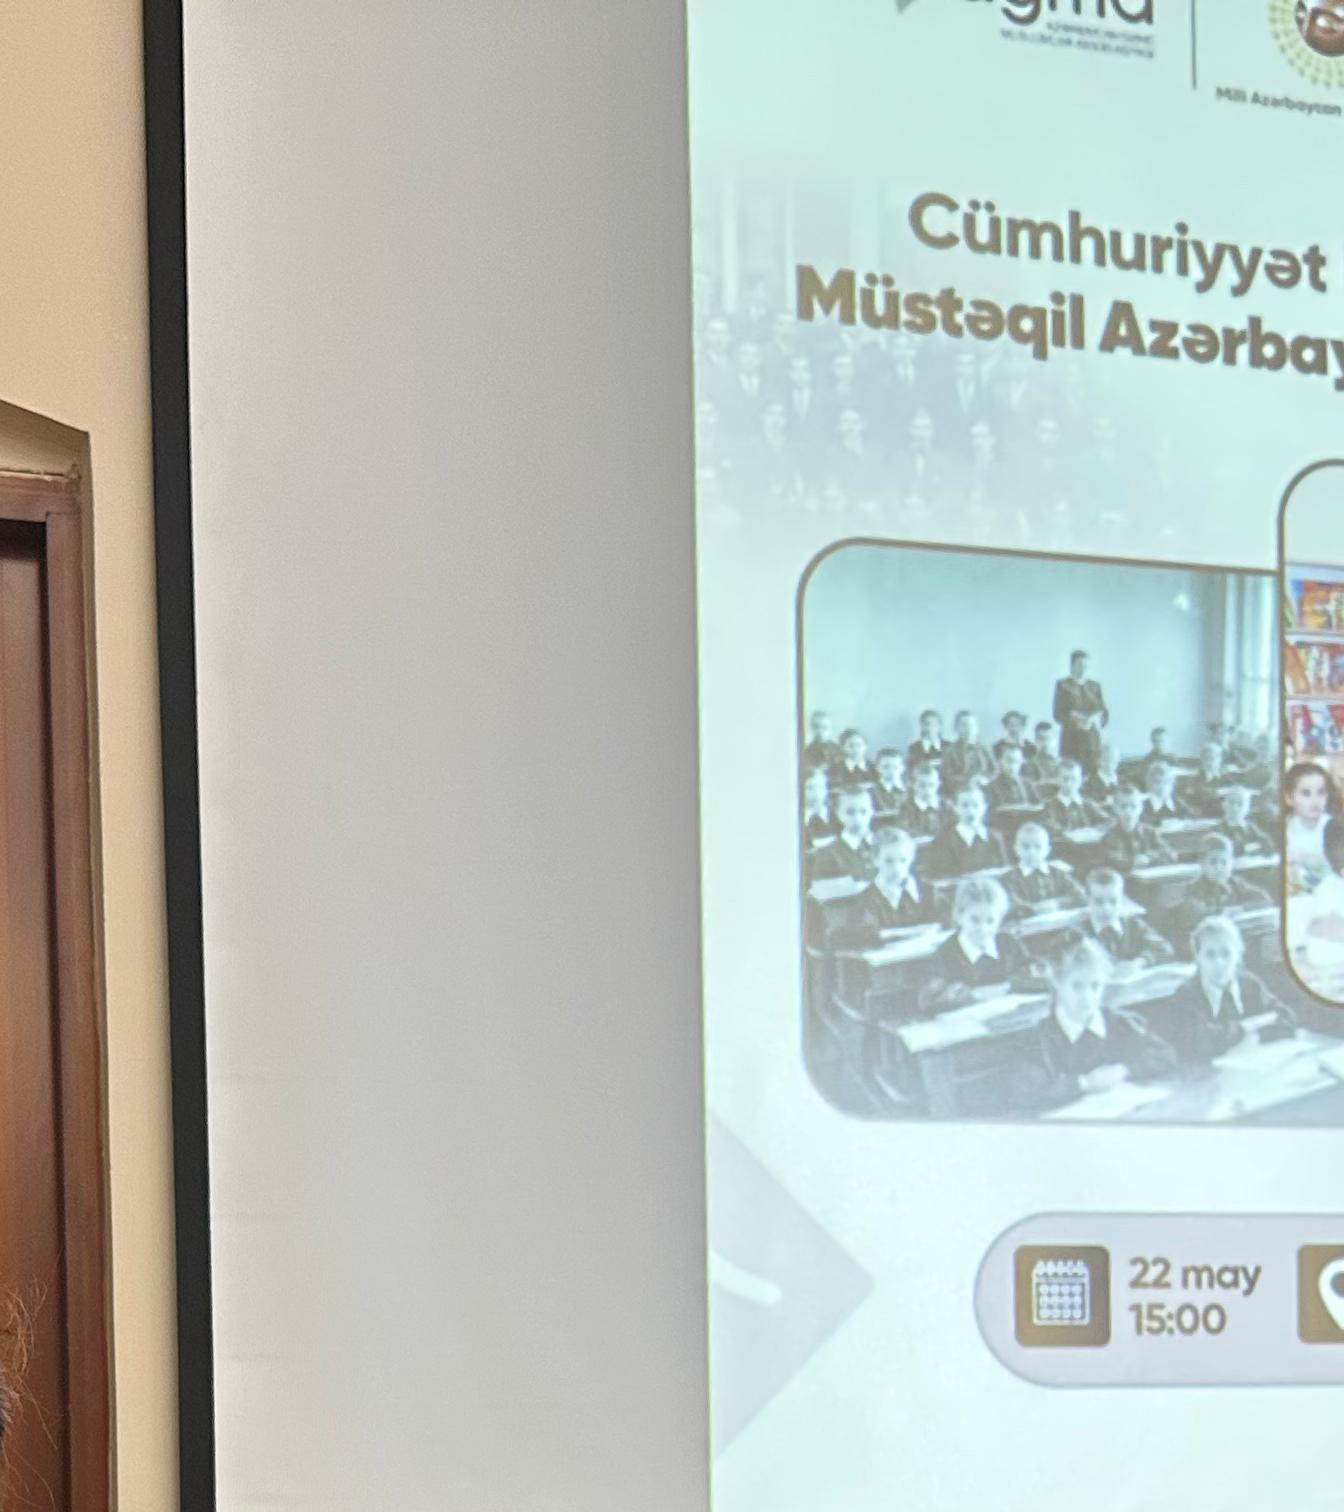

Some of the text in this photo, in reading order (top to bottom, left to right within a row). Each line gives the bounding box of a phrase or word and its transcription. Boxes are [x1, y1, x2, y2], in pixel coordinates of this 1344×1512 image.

[908, 191, 1327, 297] Cümhuriyyət
[796, 263, 1085, 361] Müstəqil
[1128, 1256, 1262, 1296] 22 may
[1128, 1303, 1227, 1335] 15:00
